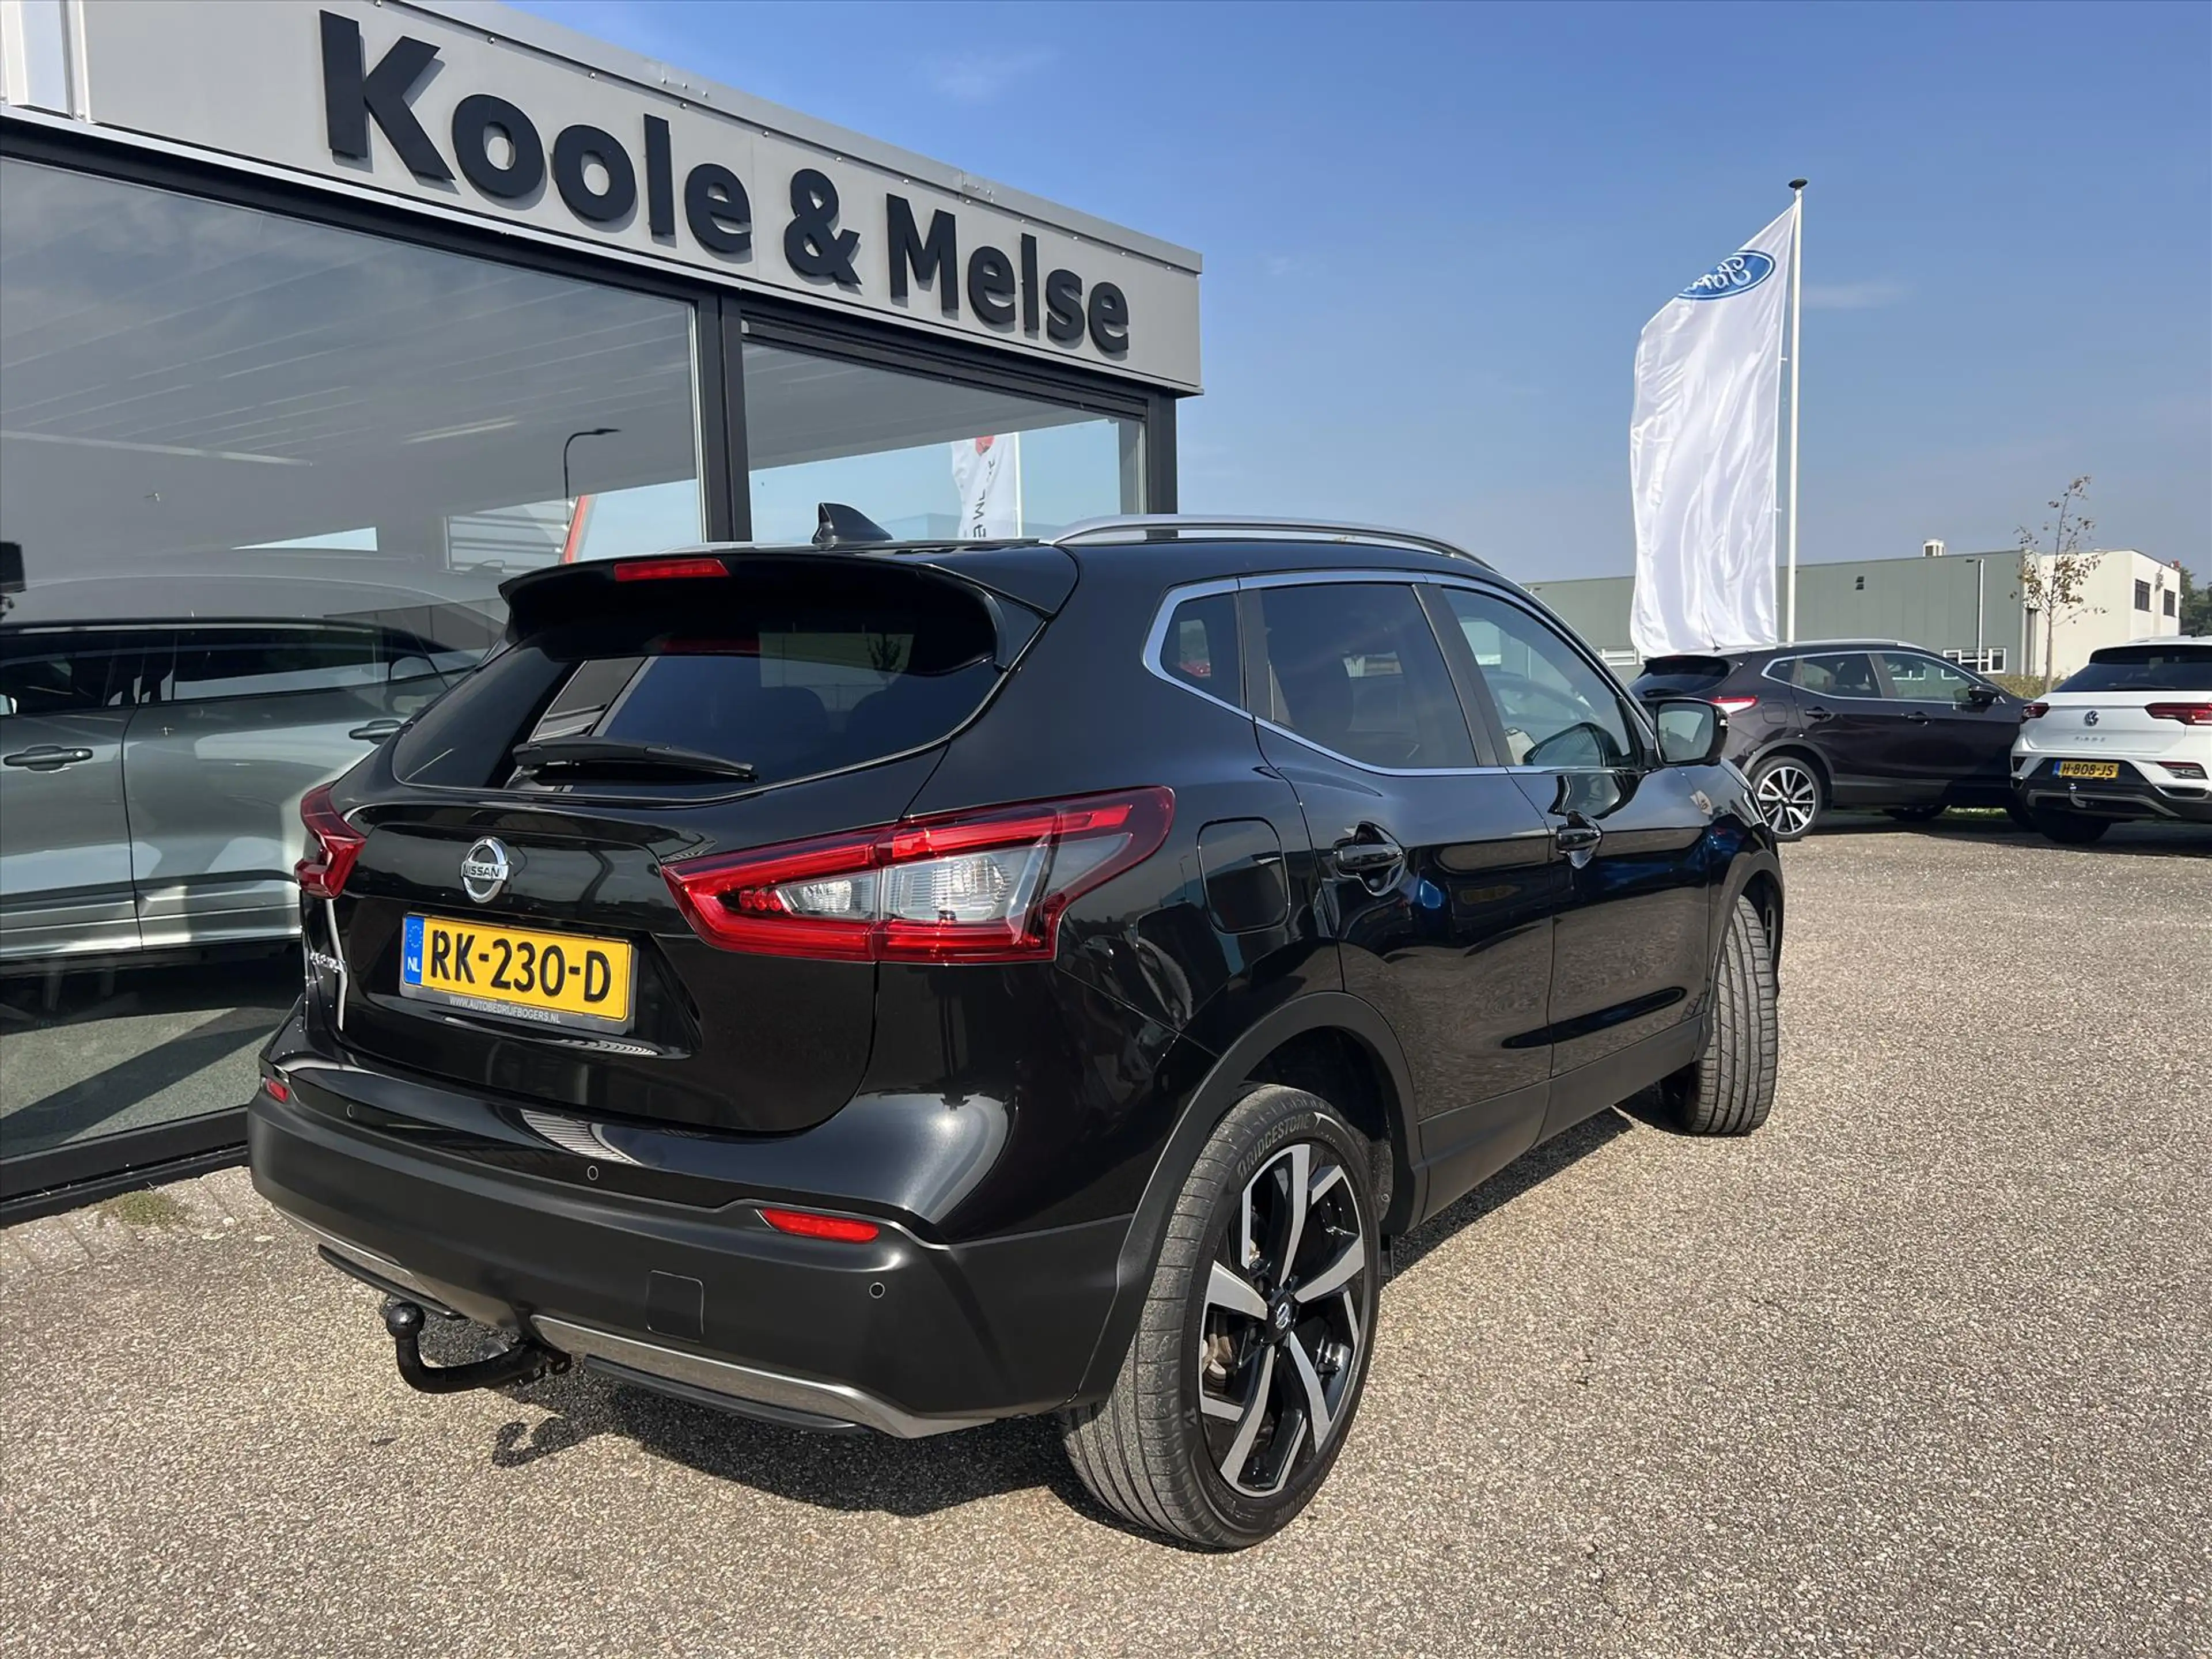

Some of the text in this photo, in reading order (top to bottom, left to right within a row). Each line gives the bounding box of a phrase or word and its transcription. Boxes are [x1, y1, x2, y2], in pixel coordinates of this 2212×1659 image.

[320, 10, 1129, 353] Koole & Melse
[2062, 763, 2115, 777] H-808-JS
[407, 956, 421, 972] NL
[431, 929, 611, 1002] RK-230-D
[449, 995, 560, 1023] WWW.AUTOBEDRIJFBOGERS.NL
